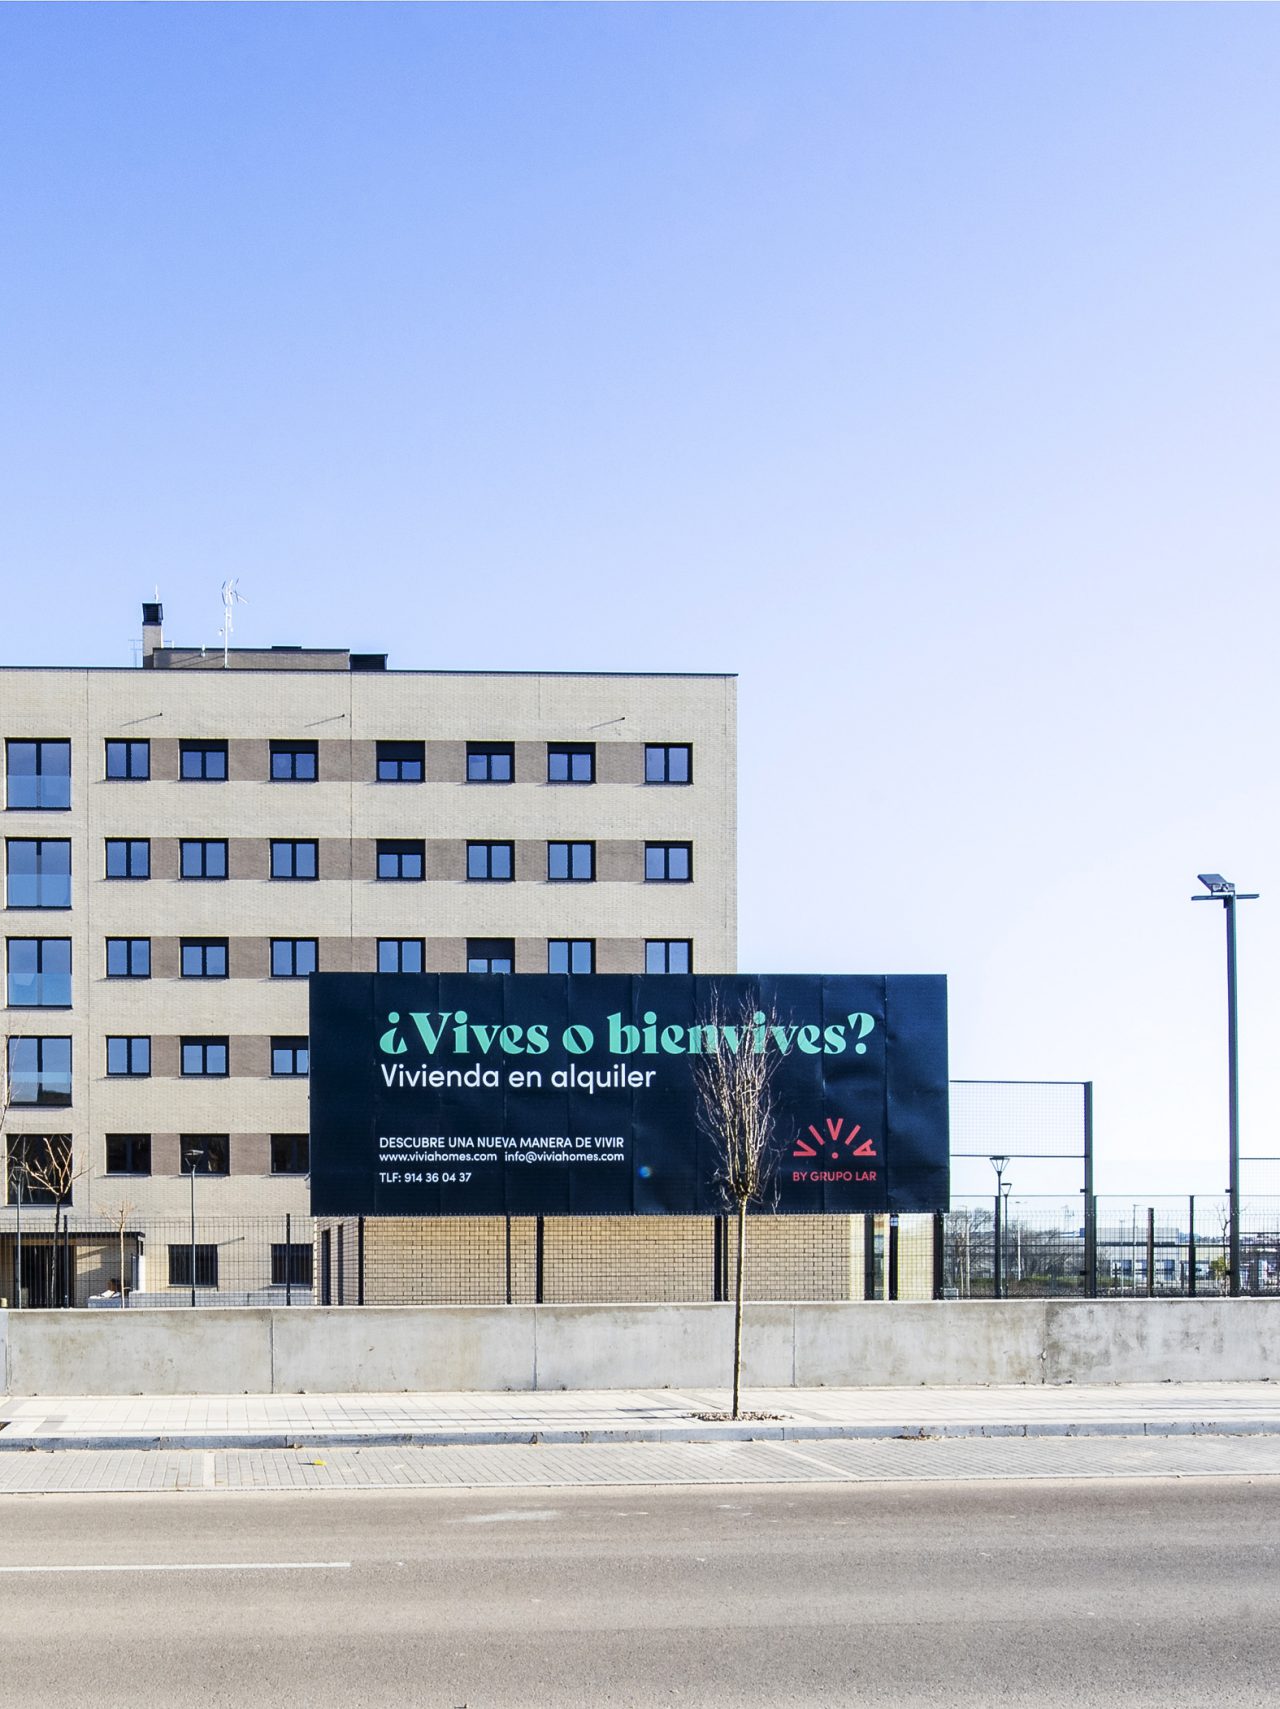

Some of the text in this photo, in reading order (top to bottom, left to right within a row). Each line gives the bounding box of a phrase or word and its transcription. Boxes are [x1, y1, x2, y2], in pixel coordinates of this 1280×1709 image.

[379, 1010, 876, 1055] ¿Vives o bienvives?
[380, 1062, 657, 1095] Vivienda en alquiler
[379, 1136, 624, 1149] DESCUBRE UNA NUEVA MANERA DE VIVIR
[792, 1117, 877, 1157] VIVIA
[379, 1150, 625, 1164] www.viviahomes.com info@viviahomes.com
[379, 1172, 472, 1183] TLF: 914 36 04 37
[792, 1171, 877, 1182] BY GRUPO LAR
